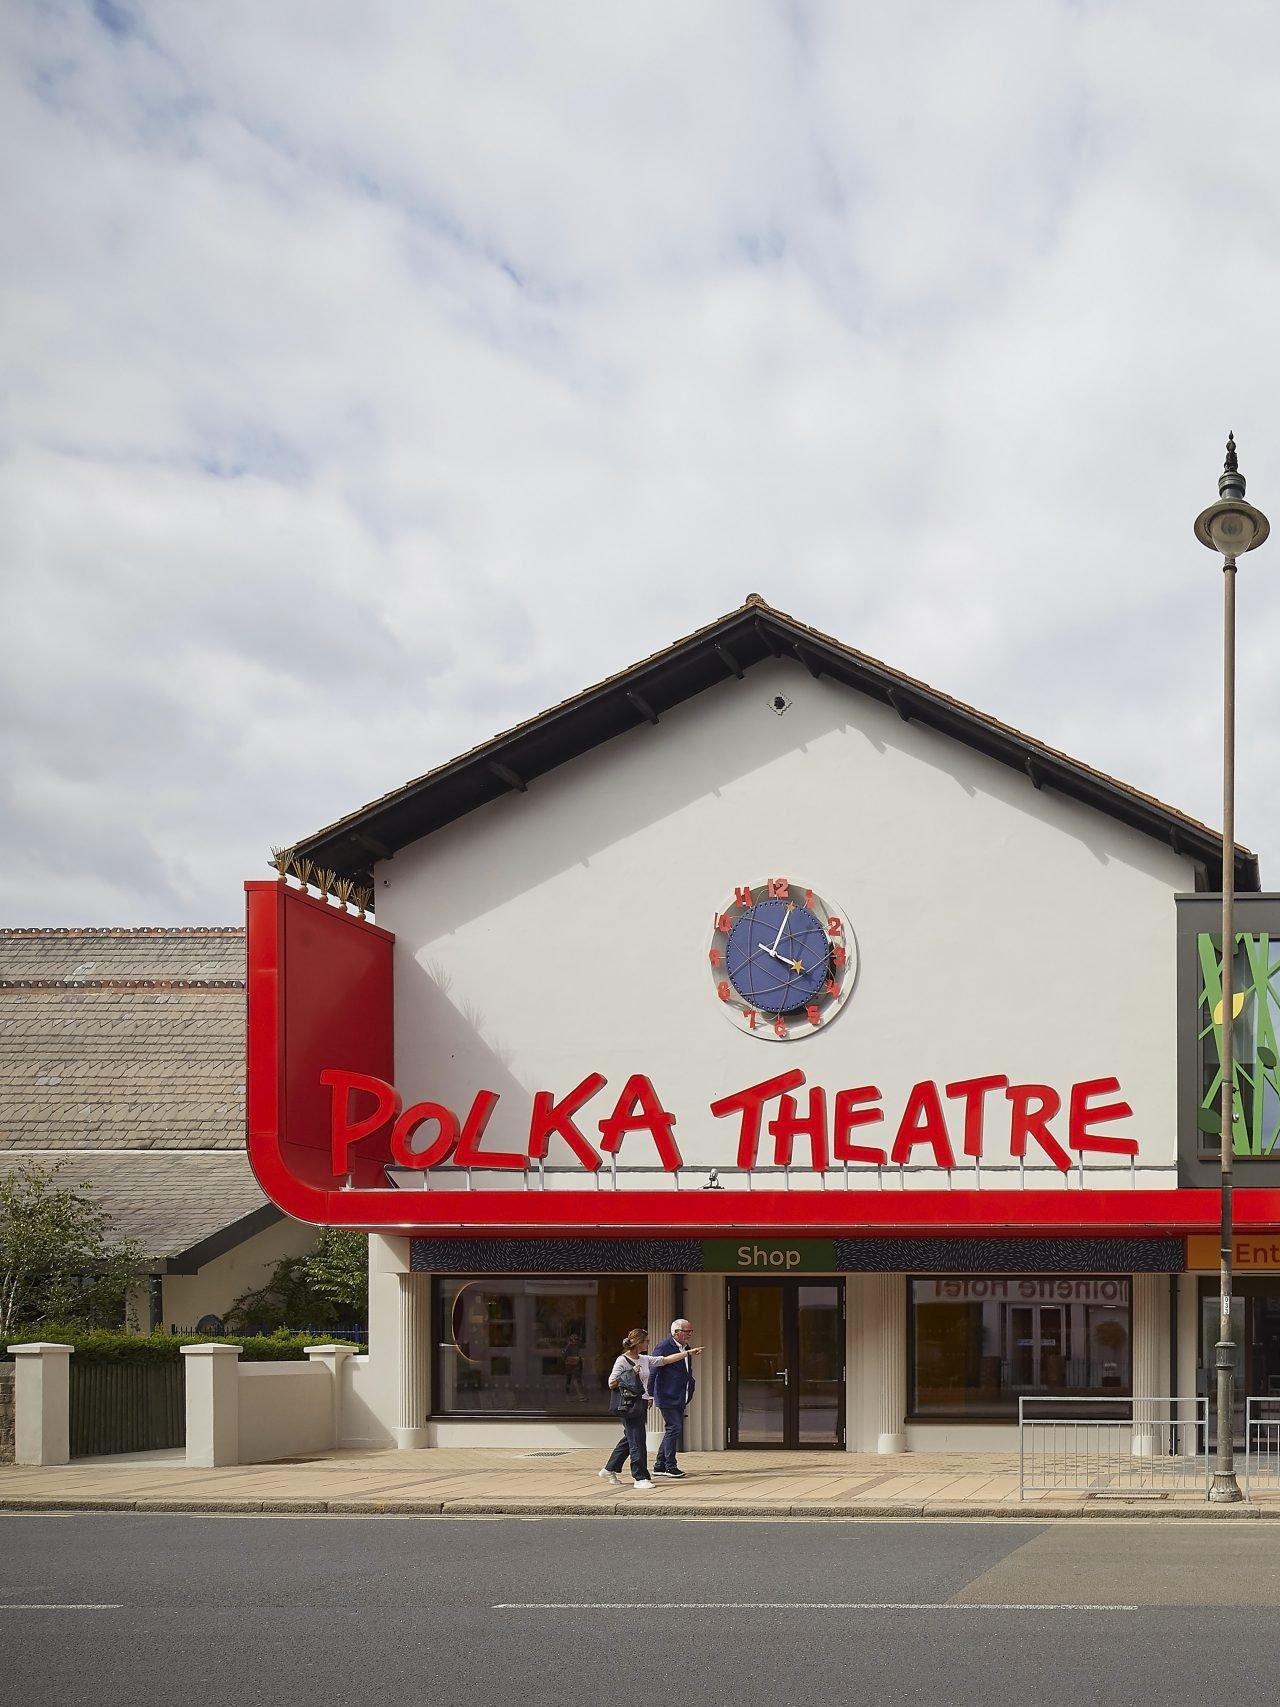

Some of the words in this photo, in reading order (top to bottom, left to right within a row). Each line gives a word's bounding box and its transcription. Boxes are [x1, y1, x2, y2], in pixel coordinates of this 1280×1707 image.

[735, 887, 753, 908] 11
[767, 878, 789, 898] 12
[805, 889, 815, 910] 1
[714, 912, 732, 933] 10
[827, 917, 842, 937] 2
[709, 948, 721, 968] 9
[833, 945, 846, 967] 3
[718, 981, 731, 1002] 8
[825, 979, 841, 999] 4
[743, 1008, 757, 1030] 7
[806, 1004, 821, 1025] 5
[774, 1016, 788, 1037] 6
[319, 1069, 684, 1177] POLKA
[710, 1068, 1140, 1173] THEATRE
[737, 1245, 801, 1270] Shop
